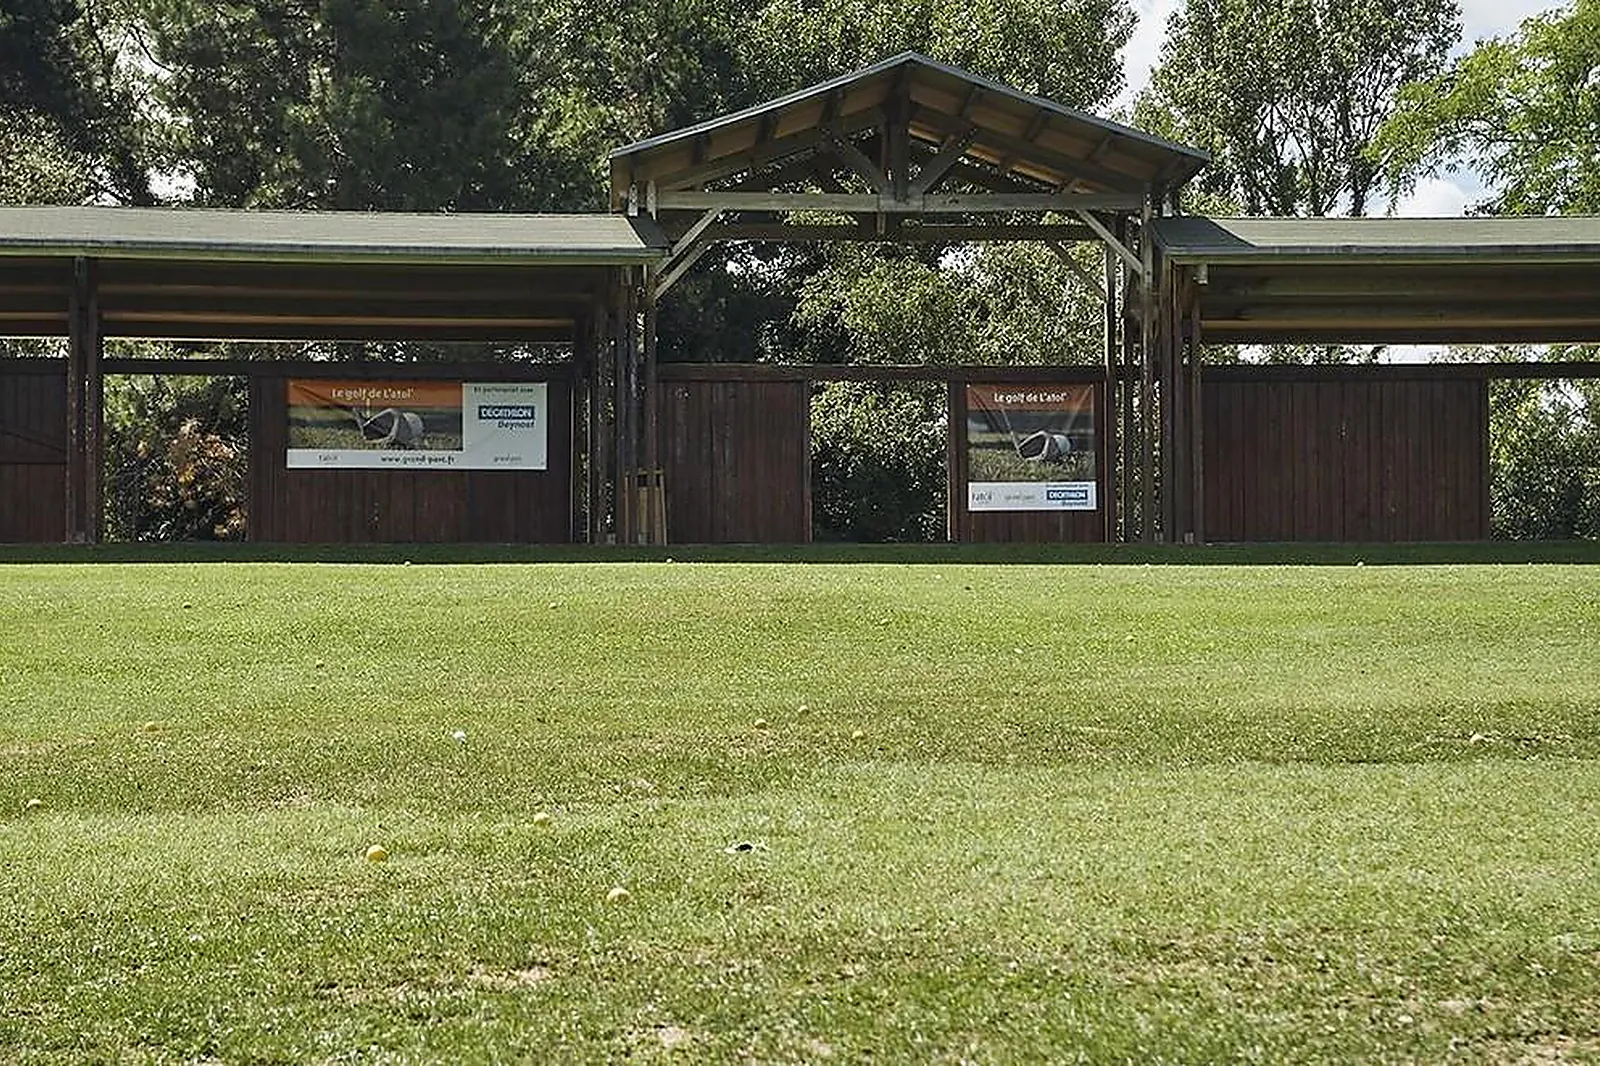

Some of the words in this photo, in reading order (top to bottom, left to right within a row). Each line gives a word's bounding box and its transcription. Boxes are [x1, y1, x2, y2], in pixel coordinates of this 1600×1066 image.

[331, 388, 343, 398] Le
[345, 387, 366, 401] golf
[368, 388, 382, 399] de
[994, 392, 1005, 402] Le
[1006, 391, 1024, 404] golf
[1026, 392, 1038, 402] de
